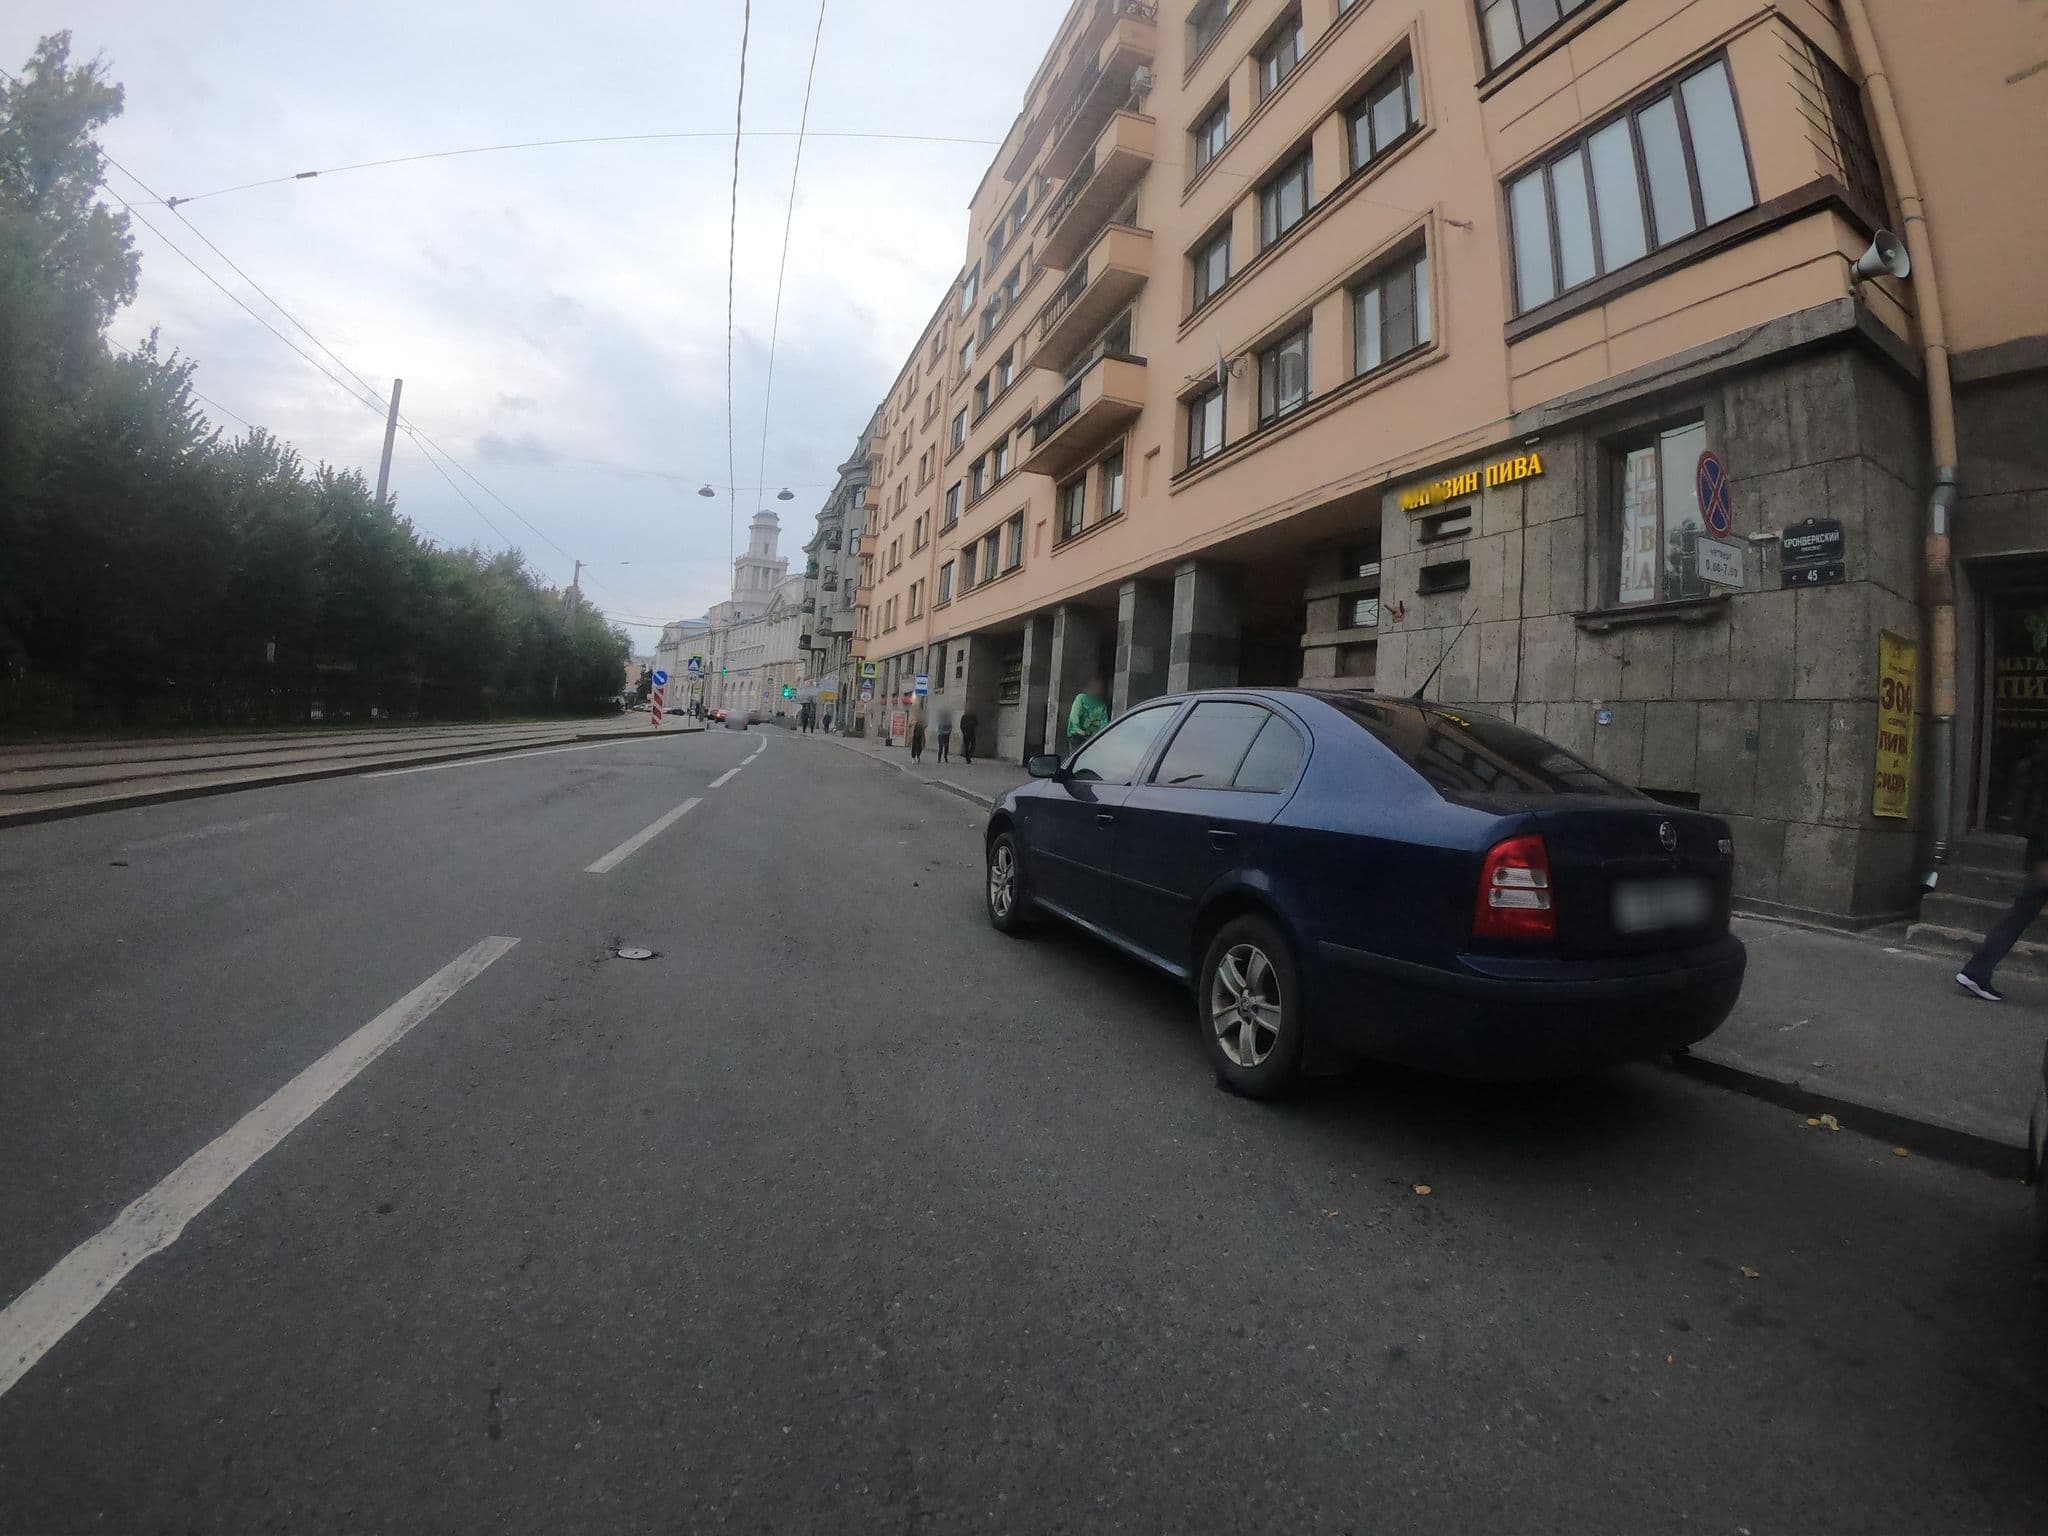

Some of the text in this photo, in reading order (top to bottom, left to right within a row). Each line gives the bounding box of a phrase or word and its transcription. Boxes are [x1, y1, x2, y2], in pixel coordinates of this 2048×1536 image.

[1485, 453, 1545, 488] ПИВА
[1783, 529, 1840, 549] КРОНВЕРКСКИЙ
[1807, 569, 1818, 581] 45
[1881, 677, 1912, 716] 300
